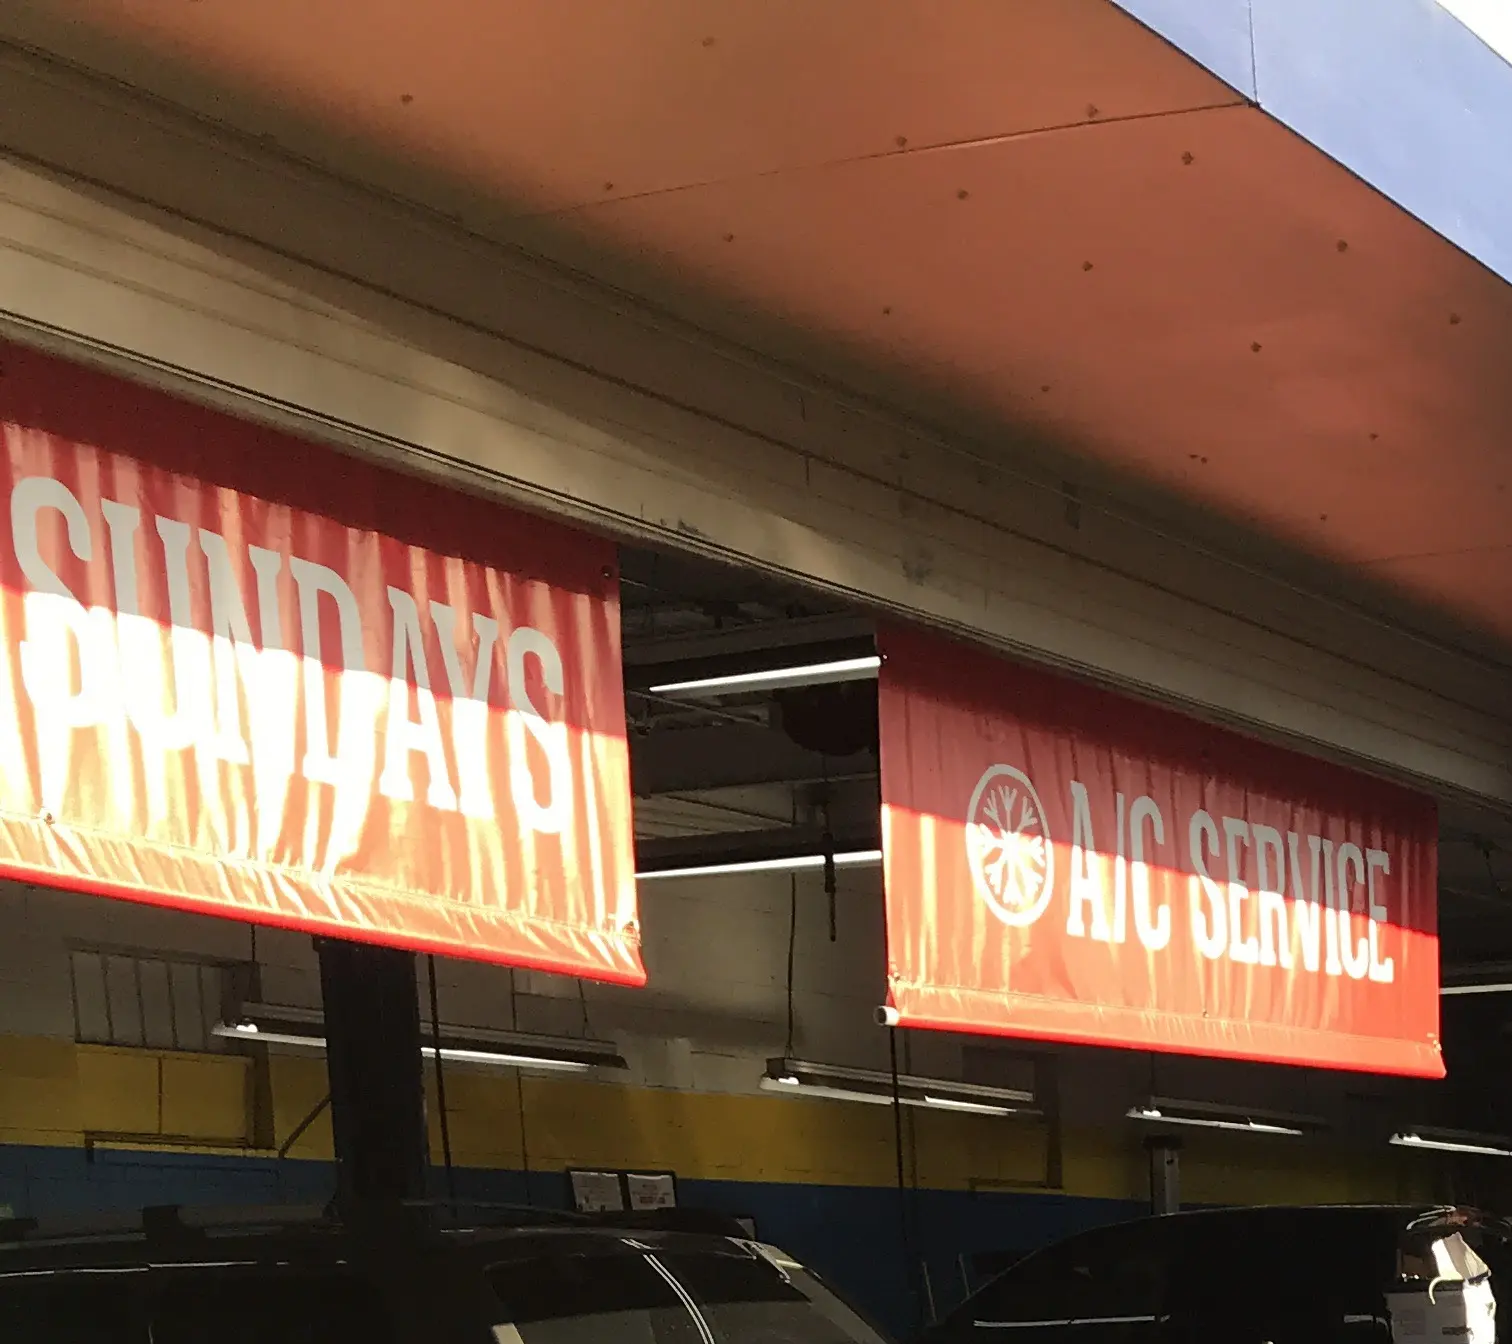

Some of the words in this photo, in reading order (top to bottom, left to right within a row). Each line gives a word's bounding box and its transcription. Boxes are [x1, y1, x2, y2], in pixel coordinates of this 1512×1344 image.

[11, 476, 576, 833] SUNDAYS
[1066, 780, 1171, 951] A/C
[1188, 808, 1393, 983] SERVICE
